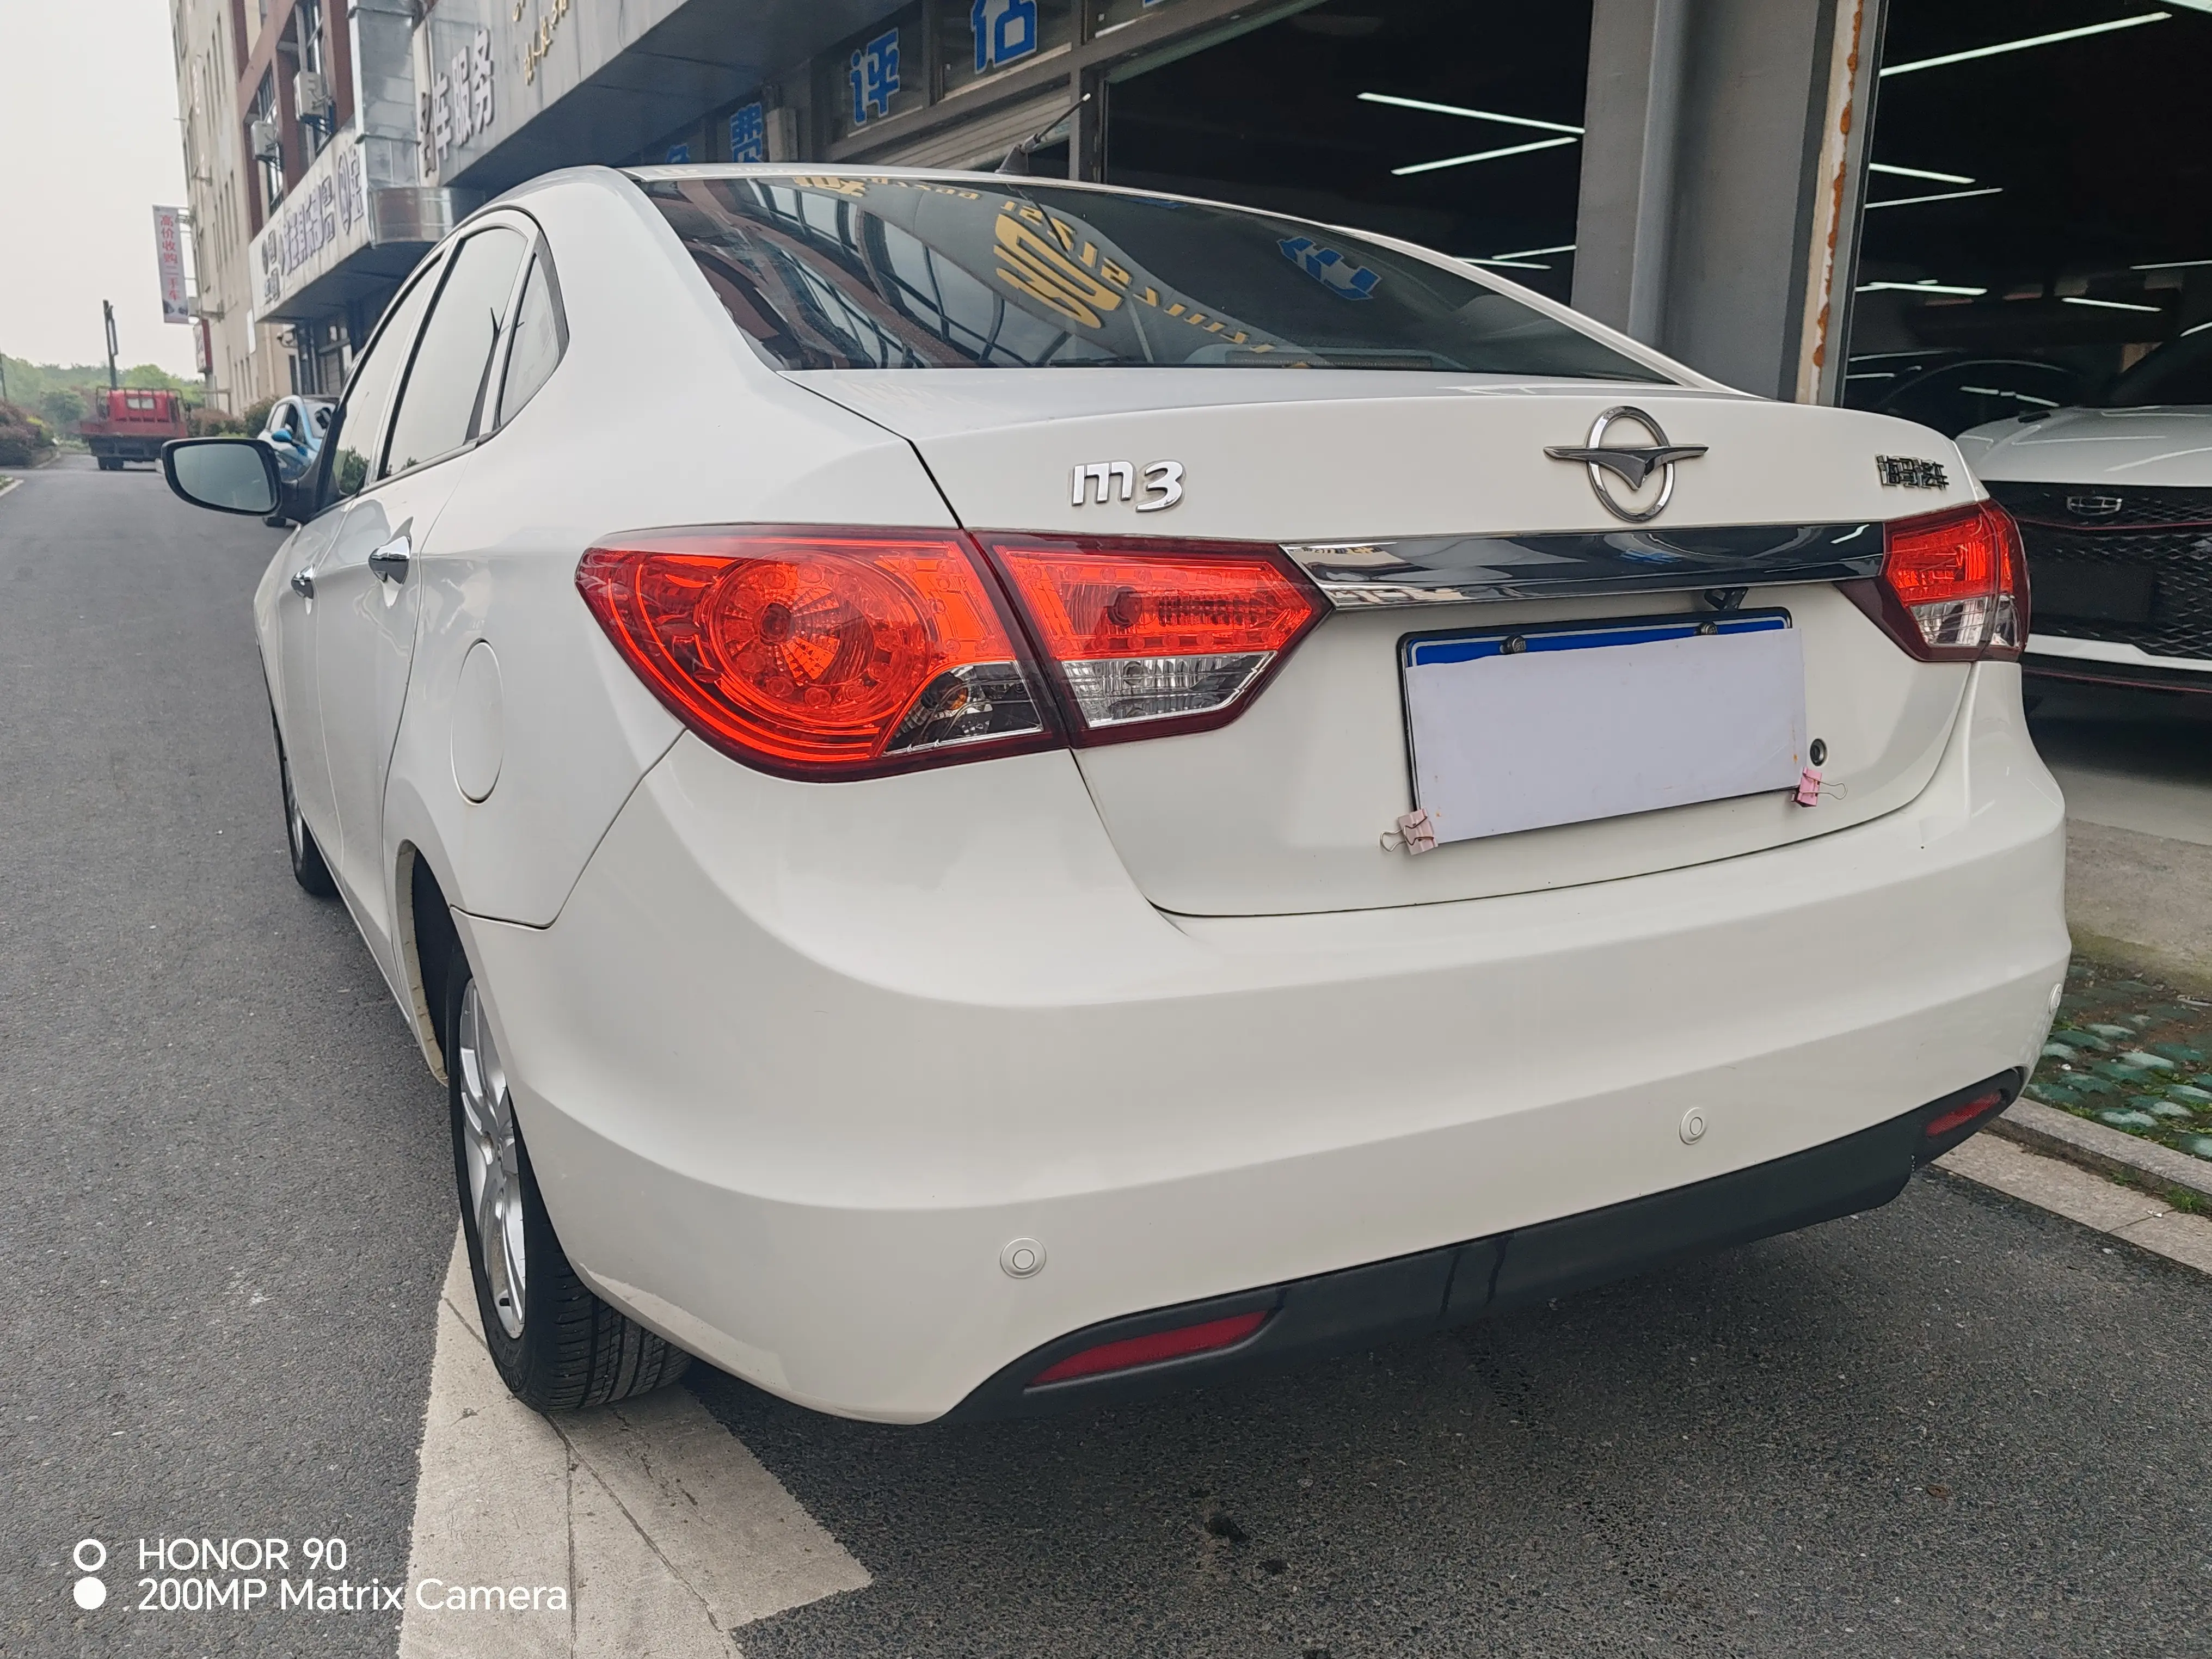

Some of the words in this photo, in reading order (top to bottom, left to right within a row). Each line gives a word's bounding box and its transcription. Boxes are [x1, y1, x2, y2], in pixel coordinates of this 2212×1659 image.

[160, 214, 181, 300] 高价收购二手车
